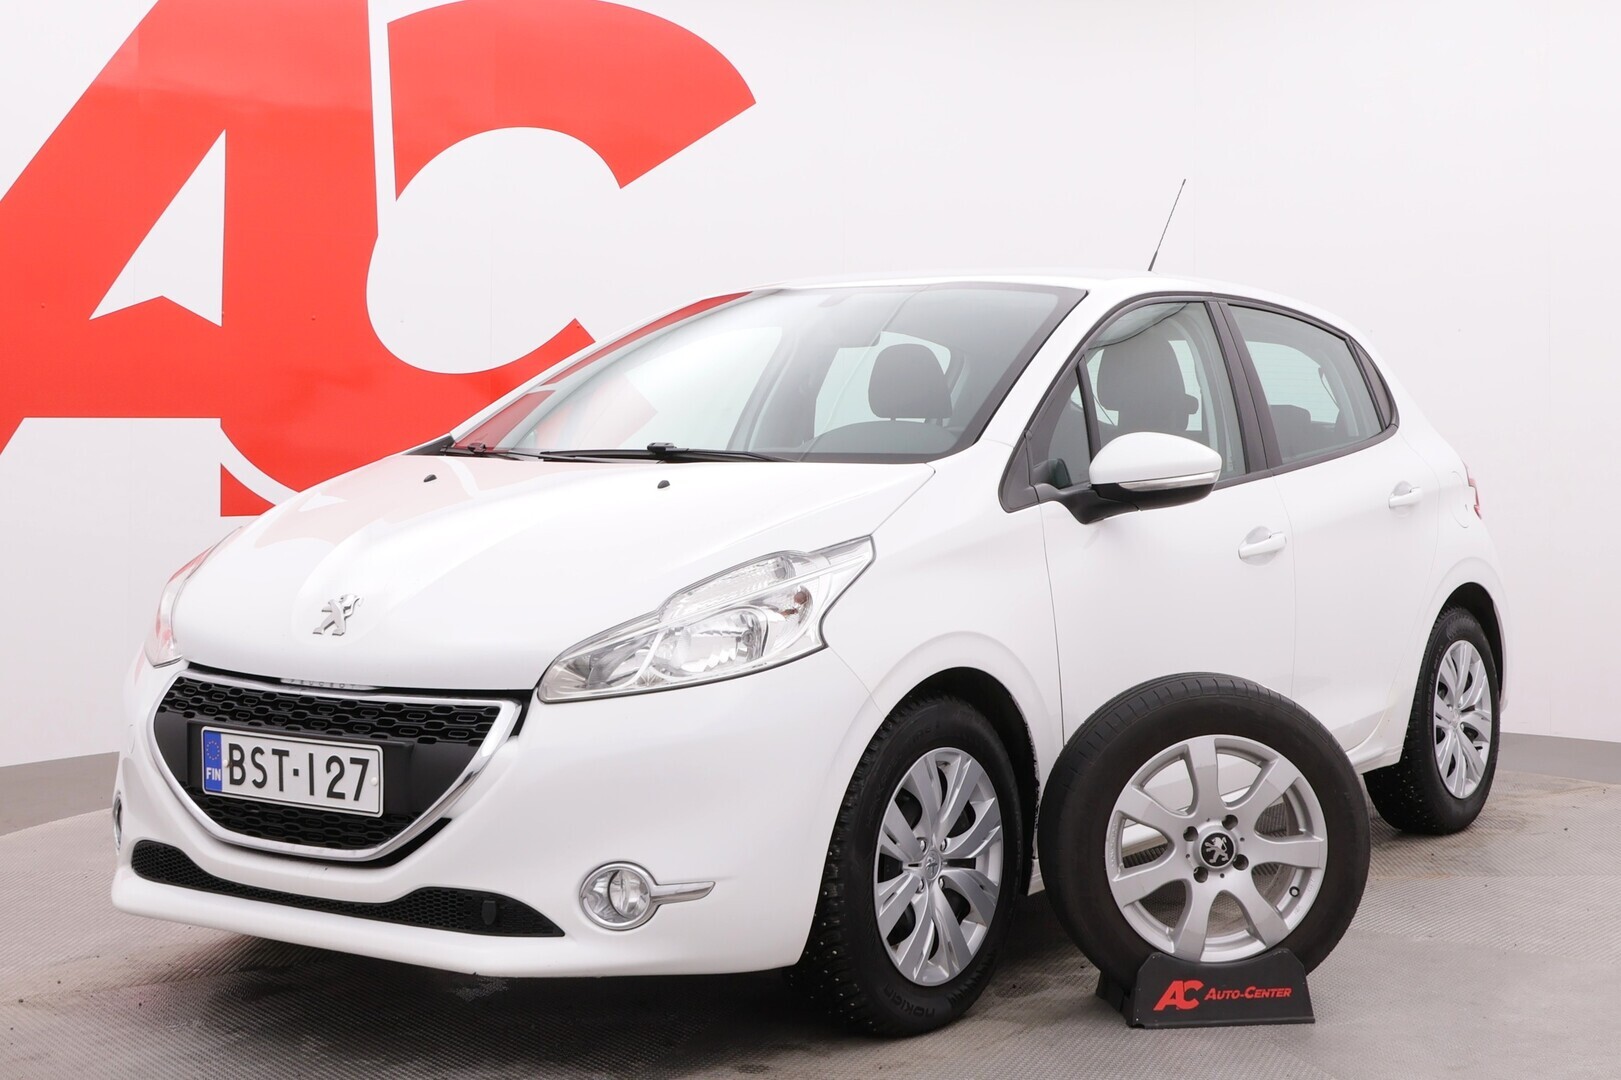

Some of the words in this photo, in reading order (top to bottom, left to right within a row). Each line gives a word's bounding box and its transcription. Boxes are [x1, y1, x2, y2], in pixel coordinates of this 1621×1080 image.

[0, 0, 757, 516] AC
[206, 766, 222, 782] FIN
[228, 743, 370, 802] BST-127
[1153, 980, 1204, 1011] AC
[1204, 986, 1292, 1001] AUTO-CENTER
